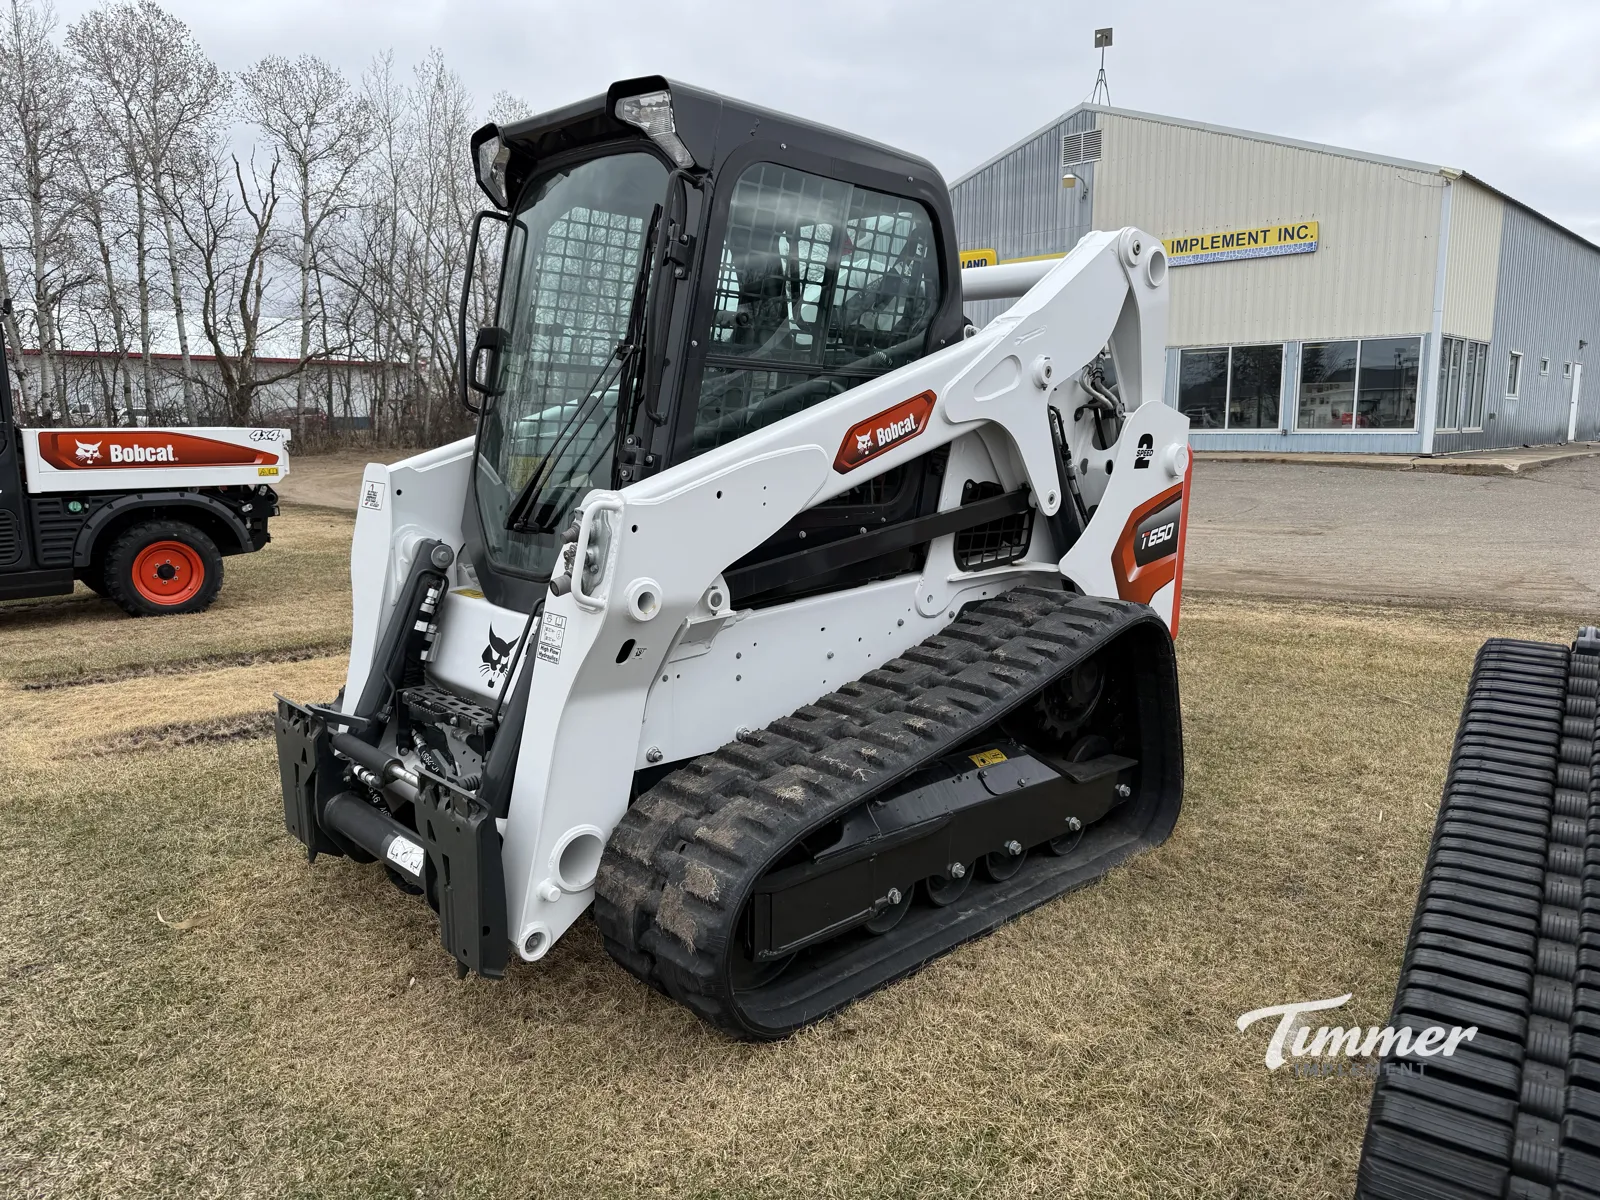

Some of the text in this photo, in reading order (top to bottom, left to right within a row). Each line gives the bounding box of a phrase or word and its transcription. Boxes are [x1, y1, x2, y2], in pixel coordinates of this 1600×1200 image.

[1171, 224, 1314, 254] IMPLEMENT INC.
[249, 429, 281, 442] 4x4
[876, 412, 917, 447] Bobcat
[109, 443, 175, 463] Bobcat
[1135, 449, 1154, 457] SPEED
[1141, 522, 1175, 550] T650
